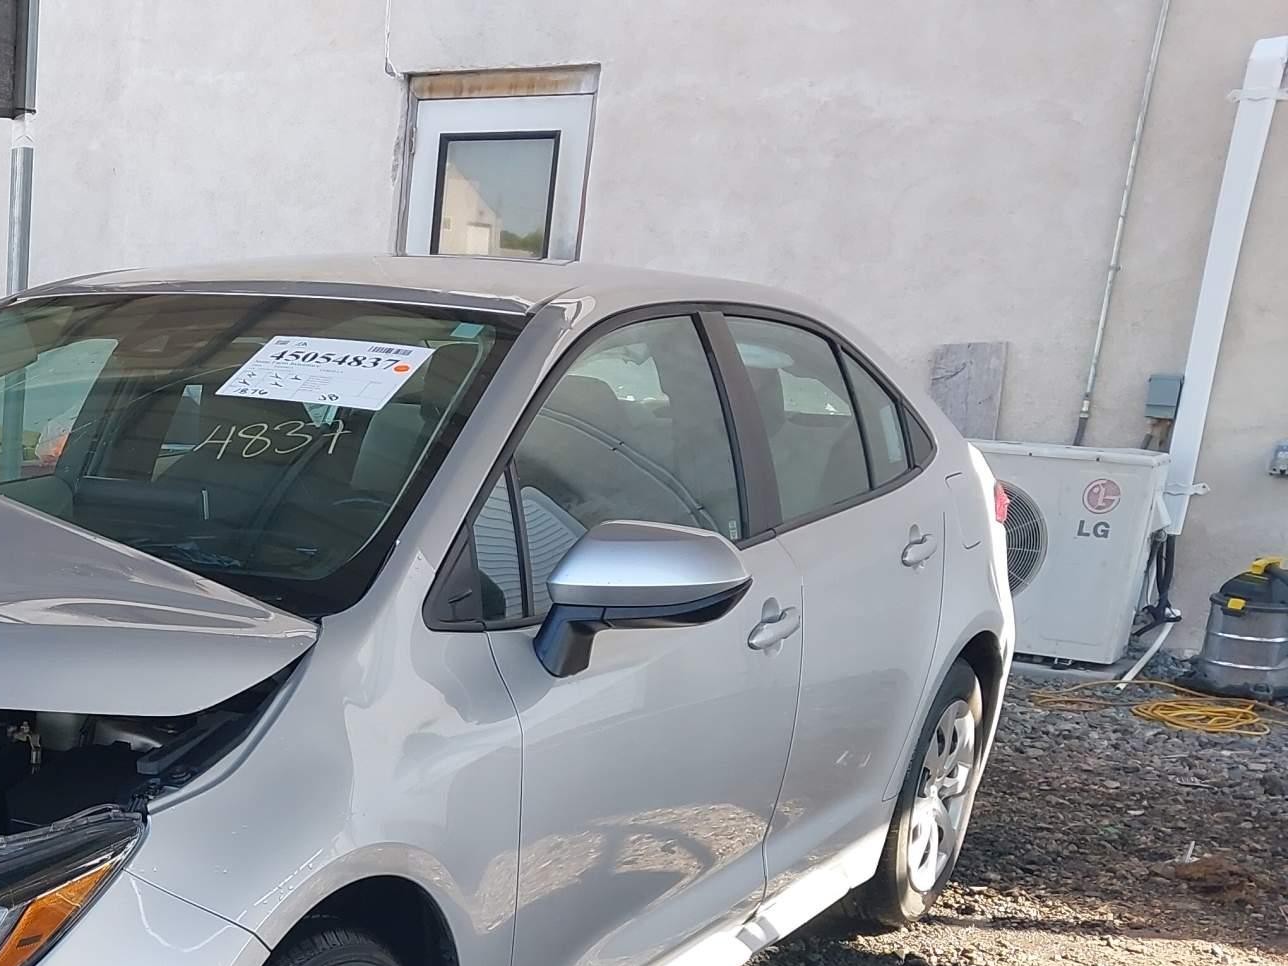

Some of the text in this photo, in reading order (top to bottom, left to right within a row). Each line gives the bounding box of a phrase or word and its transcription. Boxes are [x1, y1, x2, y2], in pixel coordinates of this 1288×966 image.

[270, 349, 400, 370] 45054837
[193, 419, 352, 460] 4837
[1077, 519, 1111, 539] LG
